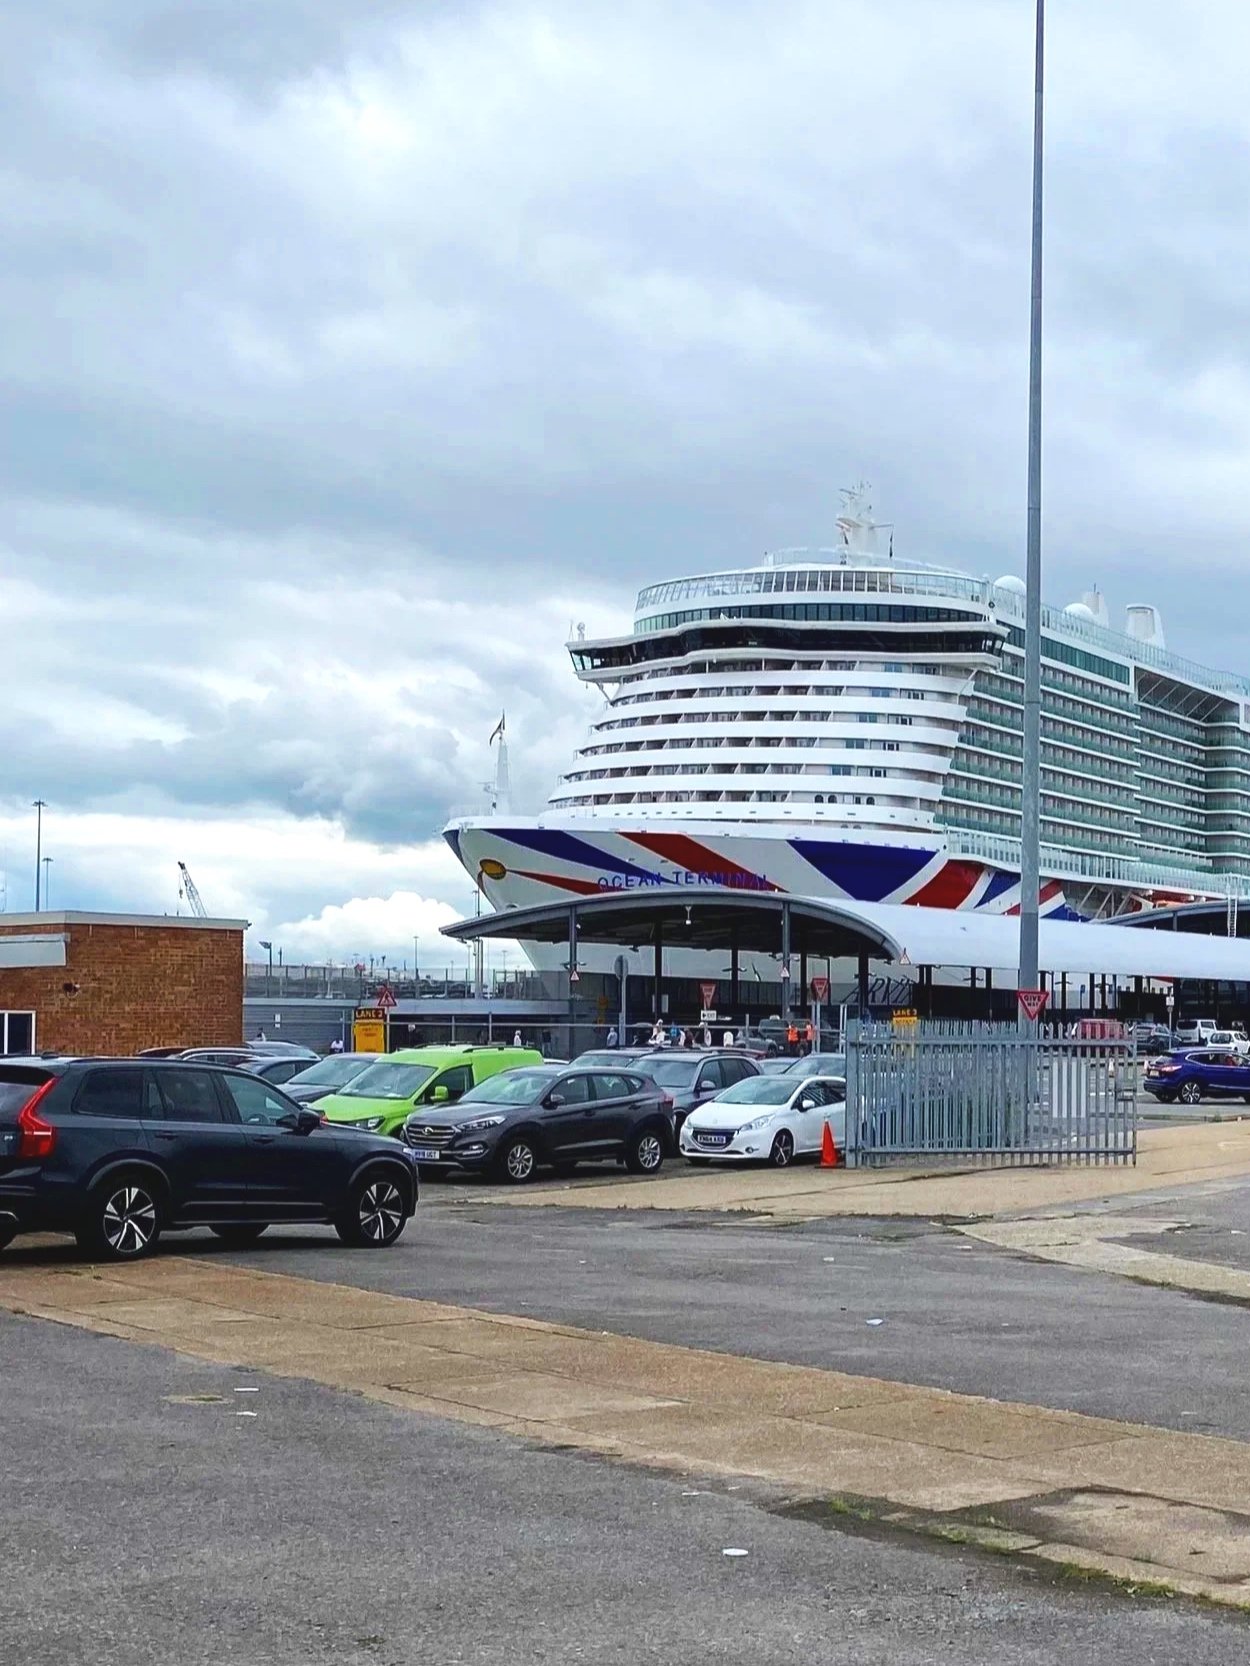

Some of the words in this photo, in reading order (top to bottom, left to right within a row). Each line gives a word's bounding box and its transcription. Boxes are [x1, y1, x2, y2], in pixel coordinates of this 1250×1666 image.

[597, 872, 661, 891] OCEAN
[672, 871, 769, 891] TERMINAL
[1024, 994, 1041, 1002] GIVE
[355, 1010, 376, 1018] LANE
